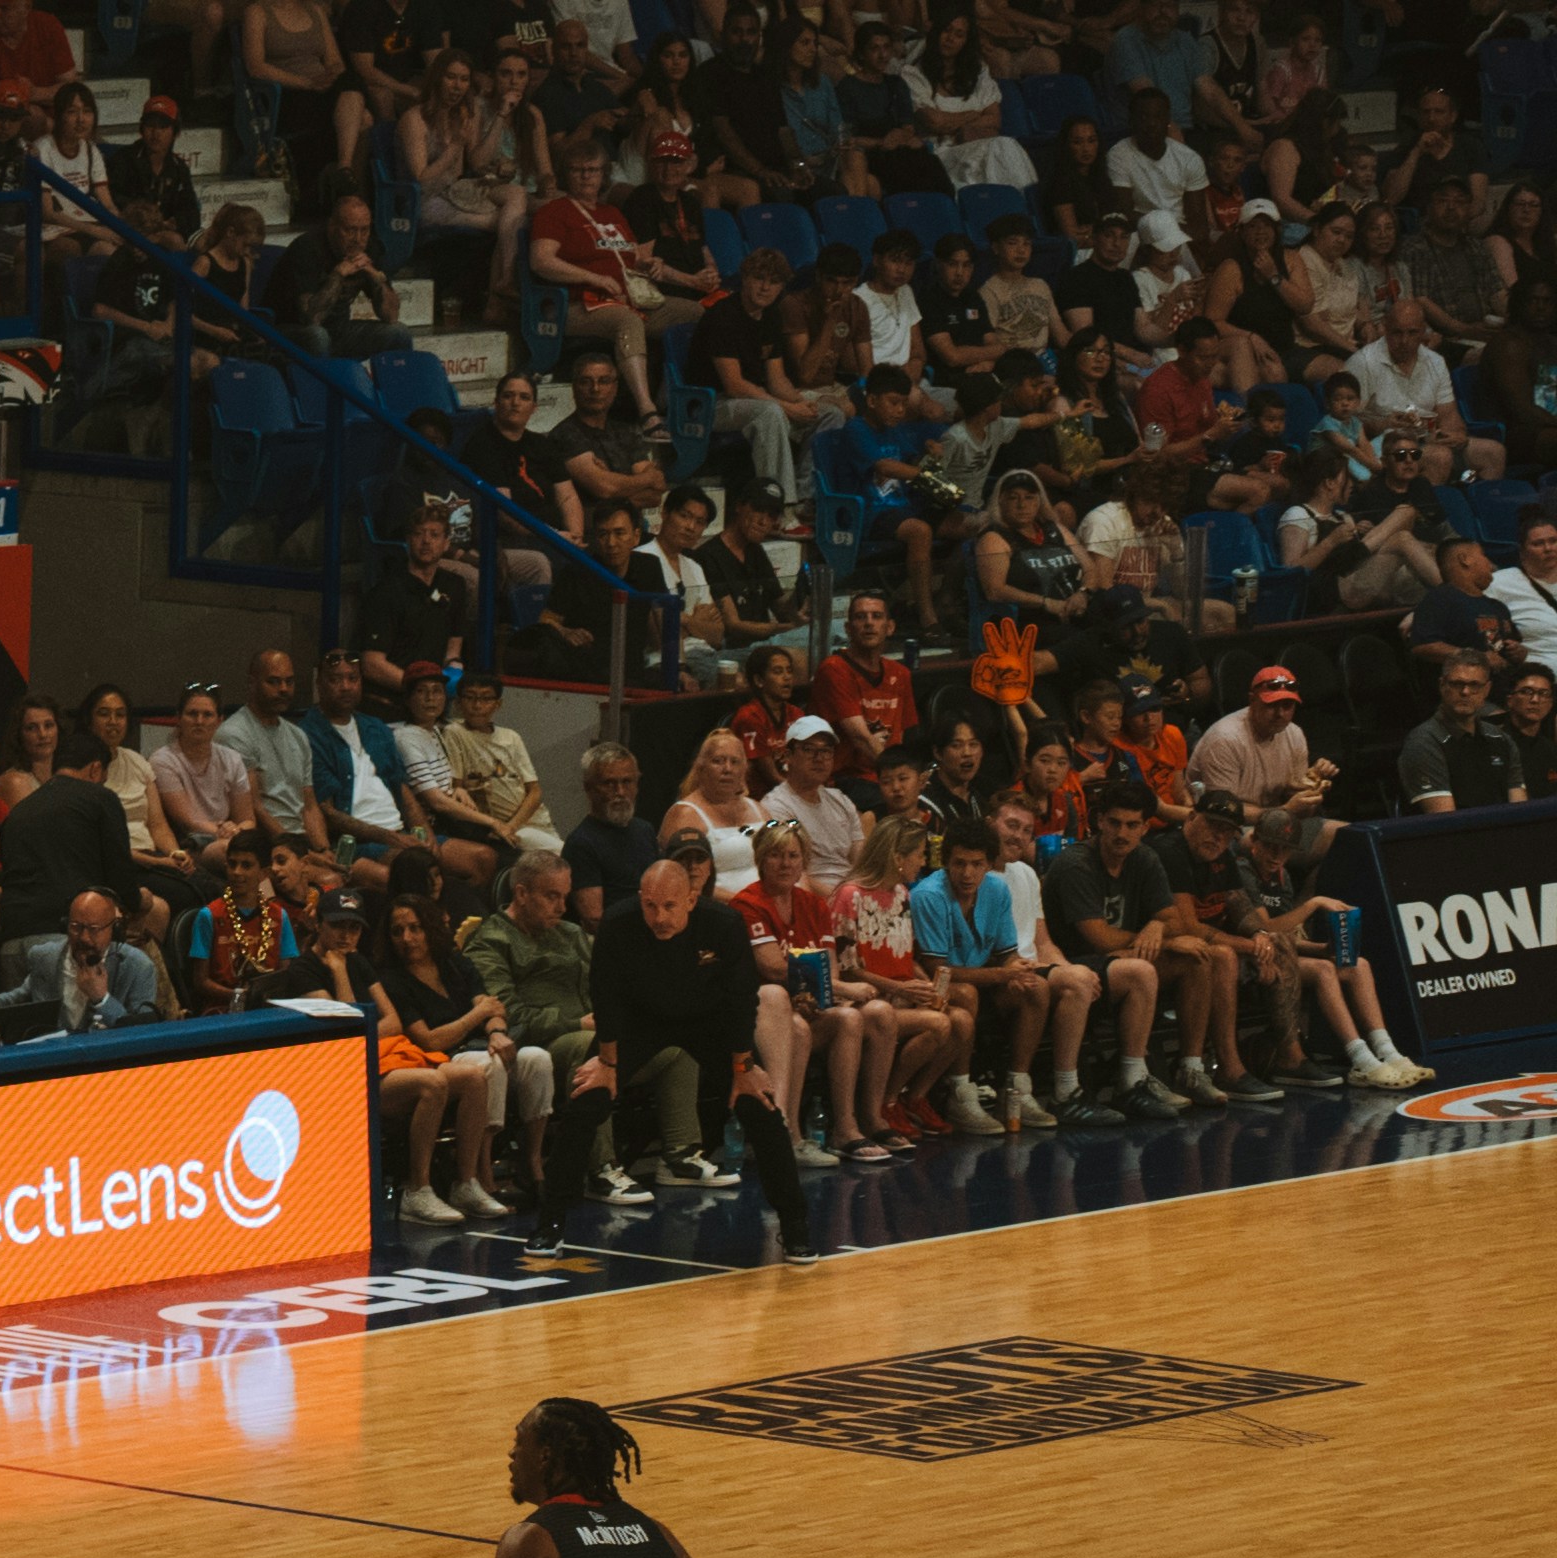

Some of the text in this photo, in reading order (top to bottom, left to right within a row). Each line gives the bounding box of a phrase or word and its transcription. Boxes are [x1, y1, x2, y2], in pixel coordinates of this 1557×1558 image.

[442, 356, 488, 375] RIGHT
[1417, 968, 1517, 999] DEALER OWNED
